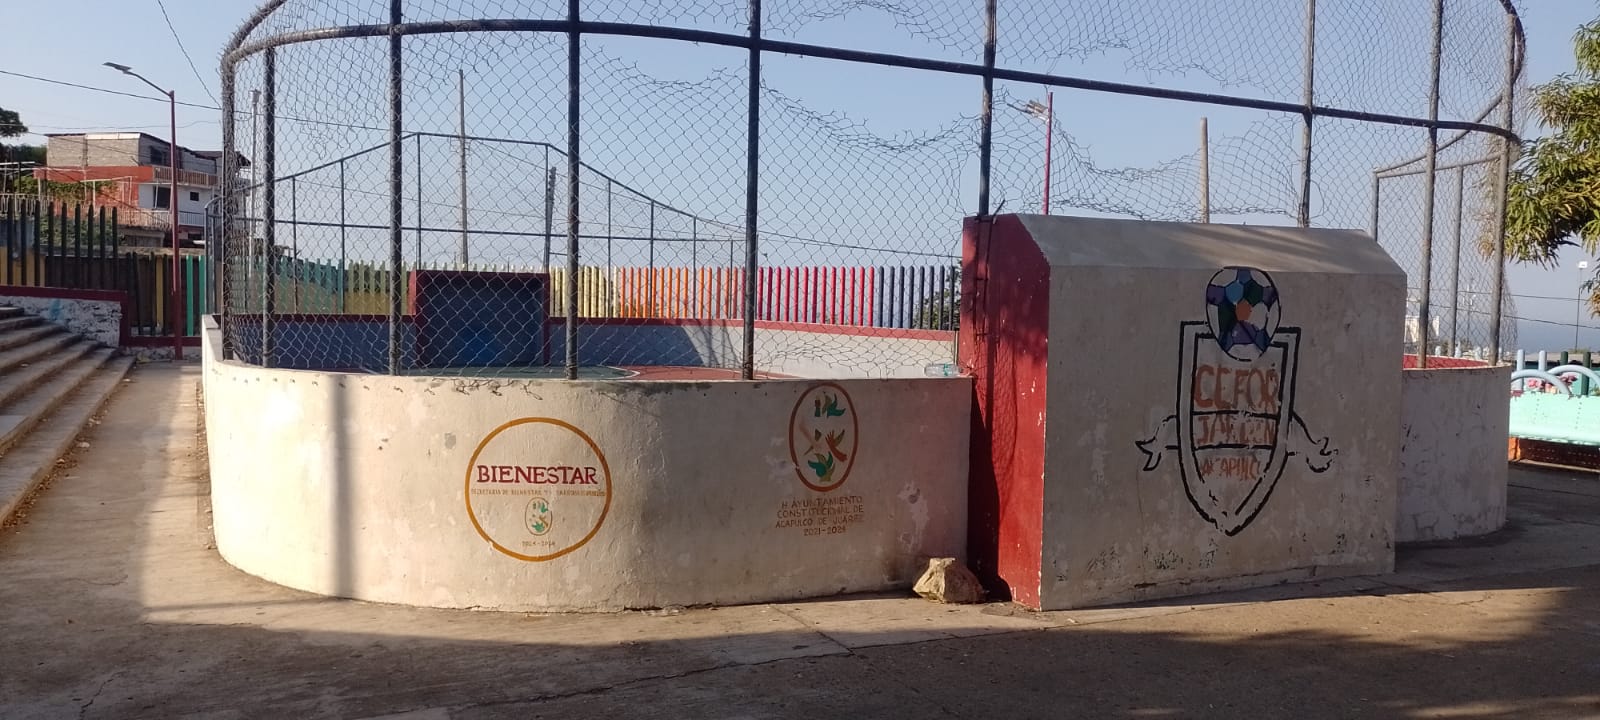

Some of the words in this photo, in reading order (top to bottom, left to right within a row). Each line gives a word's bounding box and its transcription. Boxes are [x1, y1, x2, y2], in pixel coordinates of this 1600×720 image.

[476, 465, 598, 484] BIENESTAR
[853, 504, 864, 513] DE
[775, 518, 814, 529] ACAPULCO
[818, 517, 827, 525] DE
